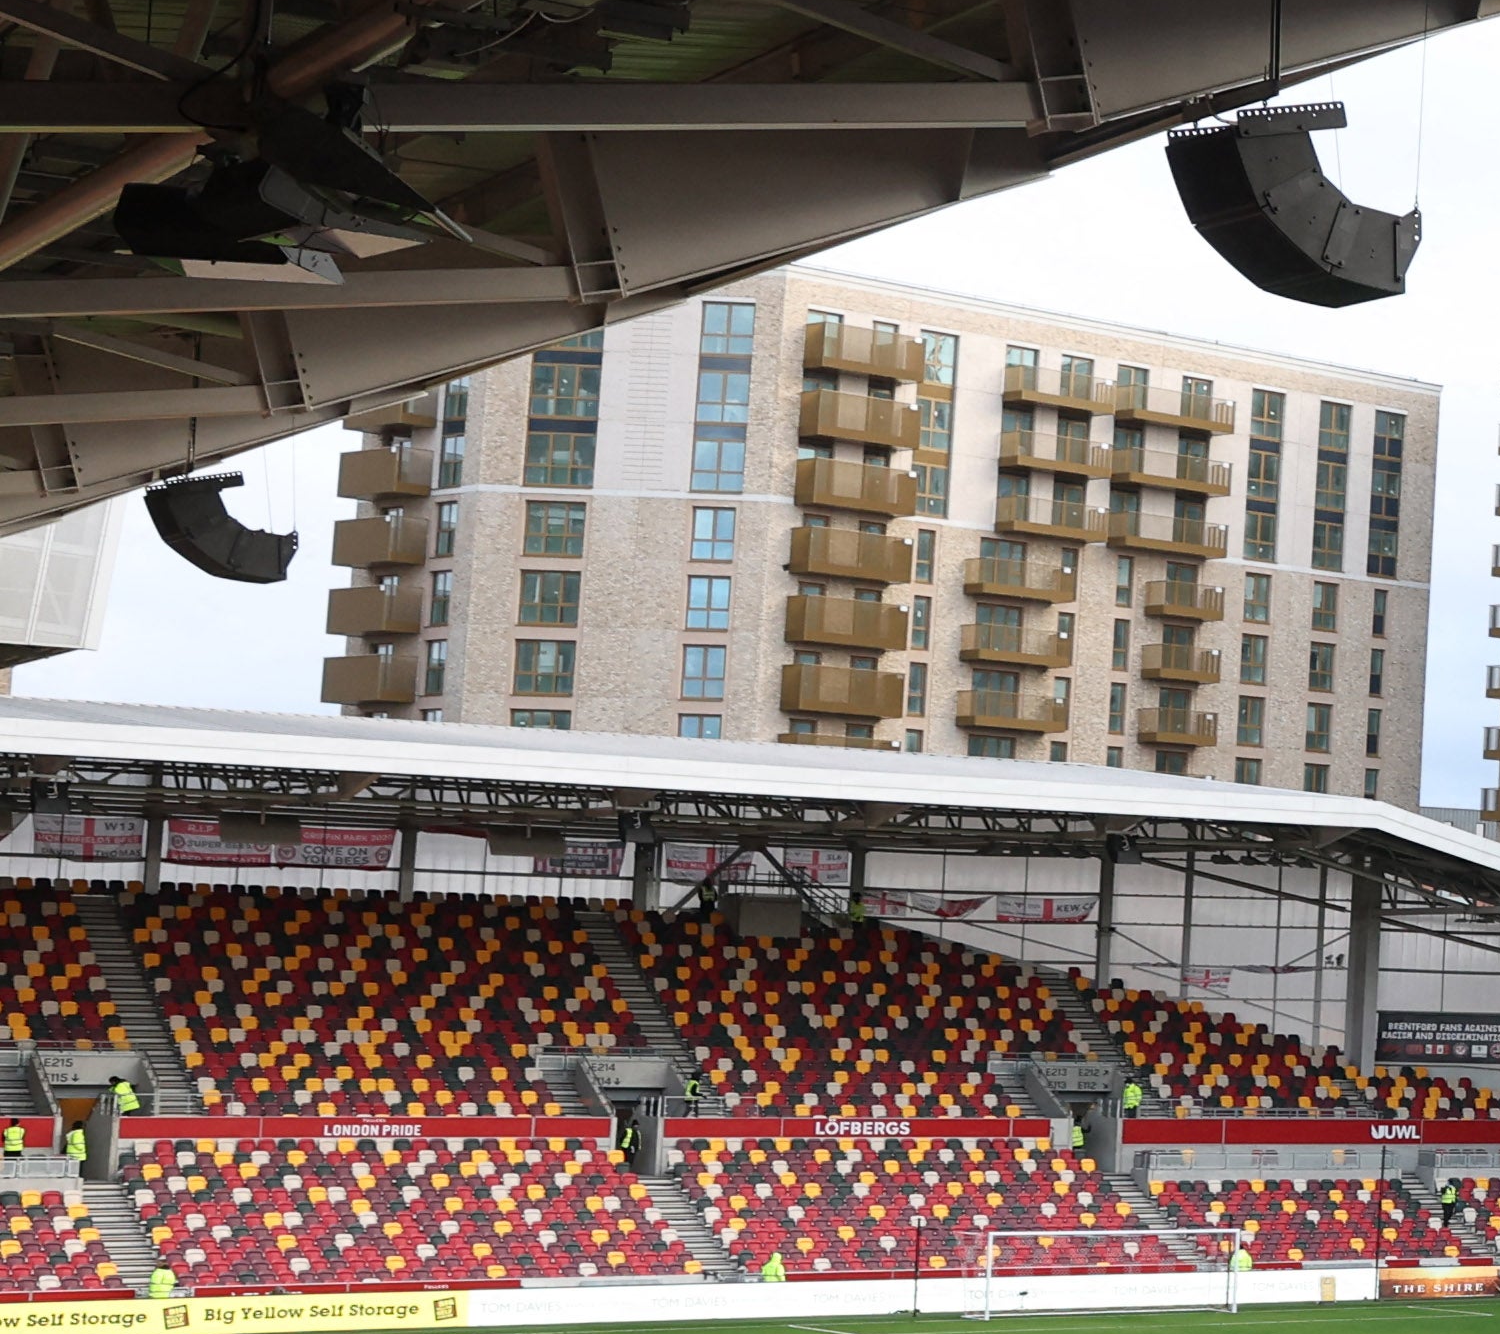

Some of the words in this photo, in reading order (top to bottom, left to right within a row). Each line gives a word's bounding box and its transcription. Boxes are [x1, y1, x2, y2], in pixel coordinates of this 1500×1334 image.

[303, 845, 343, 856] COME
[352, 846, 368, 857] ON
[334, 855, 371, 866] BEES
[1388, 1022, 1437, 1031] BRENTFORD
[1439, 1024, 1463, 1032] FANS
[1381, 1031, 1413, 1040] RACISM
[1414, 1032, 1434, 1040] AND
[44, 1057, 74, 1068] E215
[323, 1124, 380, 1136] LONDON
[381, 1124, 422, 1136] PRIDE
[814, 1118, 911, 1136] LÖFBERGS
[1393, 1284, 1426, 1294] THE
[1433, 1283, 1484, 1293] SHIRE
[205, 1308, 236, 1325] Big
[241, 1306, 304, 1320] Yellow
[310, 1303, 344, 1318] Self
[349, 1303, 420, 1319] Storage
[27, 1312, 64, 1327] Self
[70, 1312, 147, 1329] Storage
